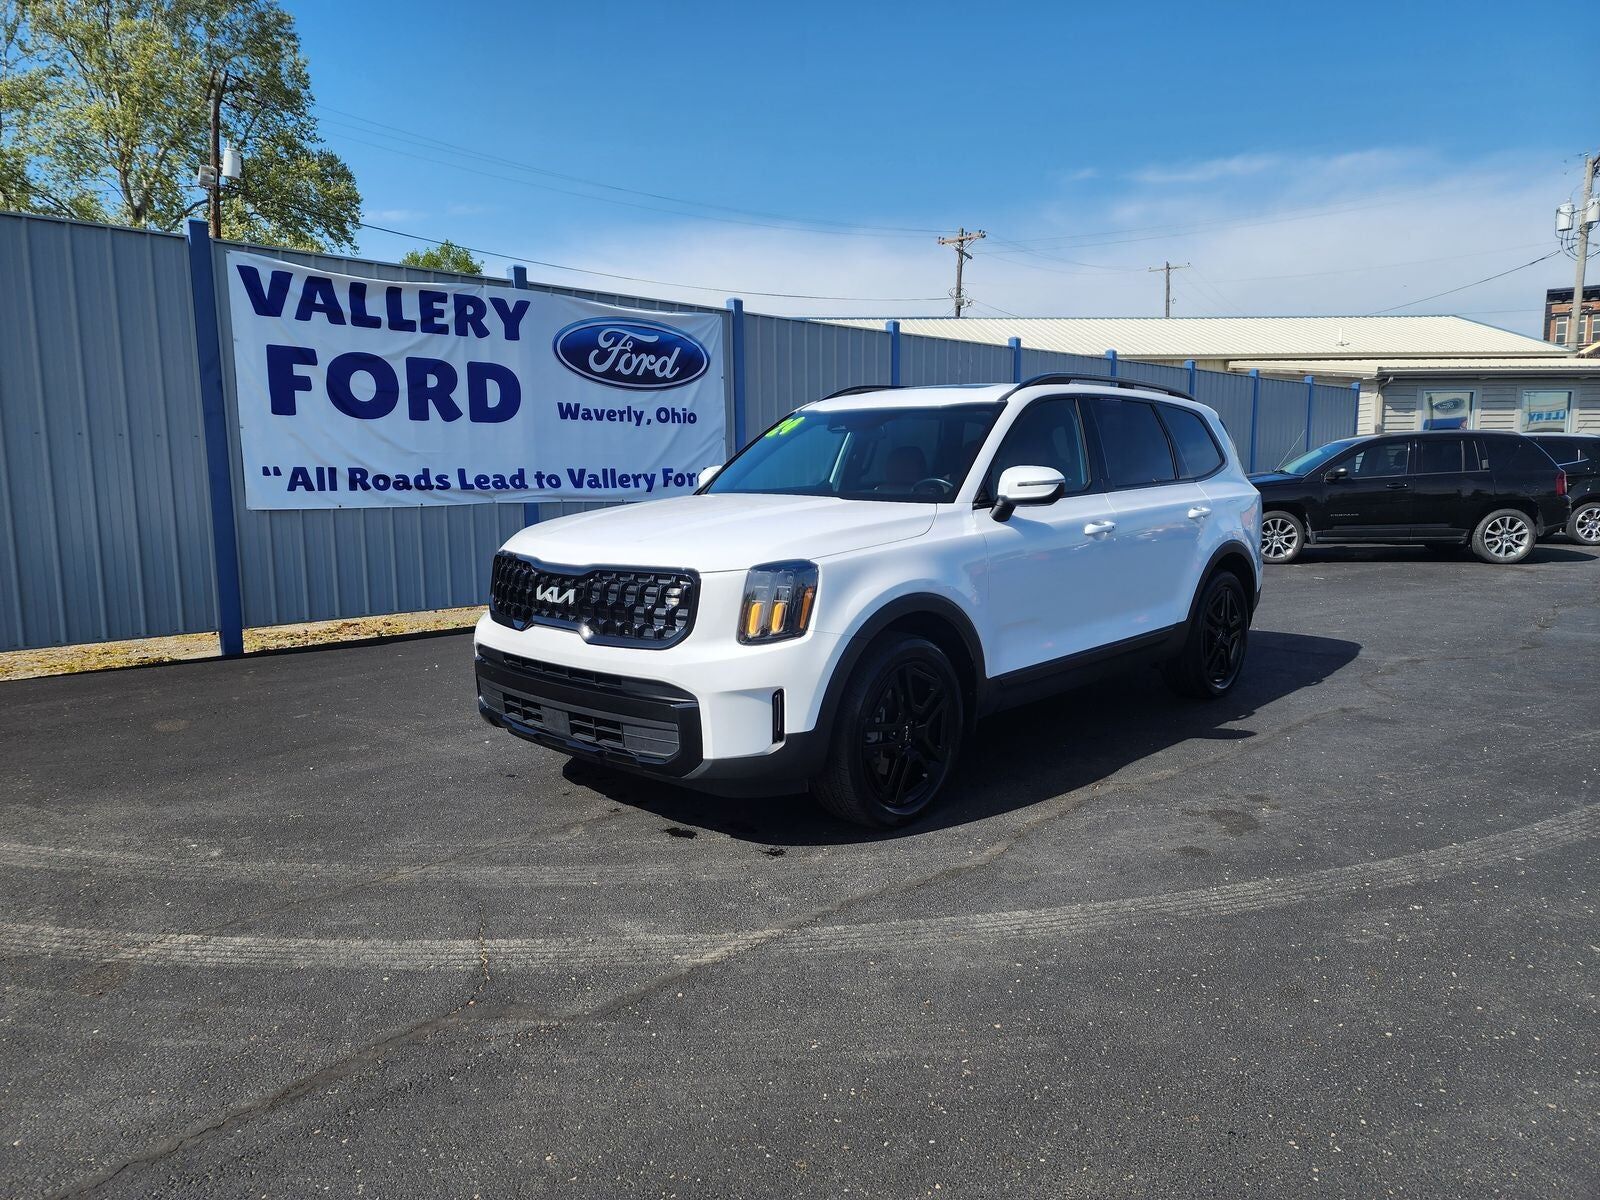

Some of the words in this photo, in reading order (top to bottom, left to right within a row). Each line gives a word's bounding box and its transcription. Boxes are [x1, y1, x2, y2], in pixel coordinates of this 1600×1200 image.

[236, 264, 531, 341] VALLERY
[588, 328, 682, 379] Ford
[266, 344, 522, 424] FORD
[557, 402, 652, 427] Waverly,
[655, 406, 697, 425] Ohio
[348, 467, 451, 492] Roads
[457, 468, 529, 490] Lead
[534, 471, 562, 489] to
[567, 468, 656, 493] Vallery
[662, 467, 704, 488] For
[536, 584, 576, 605] KIA
